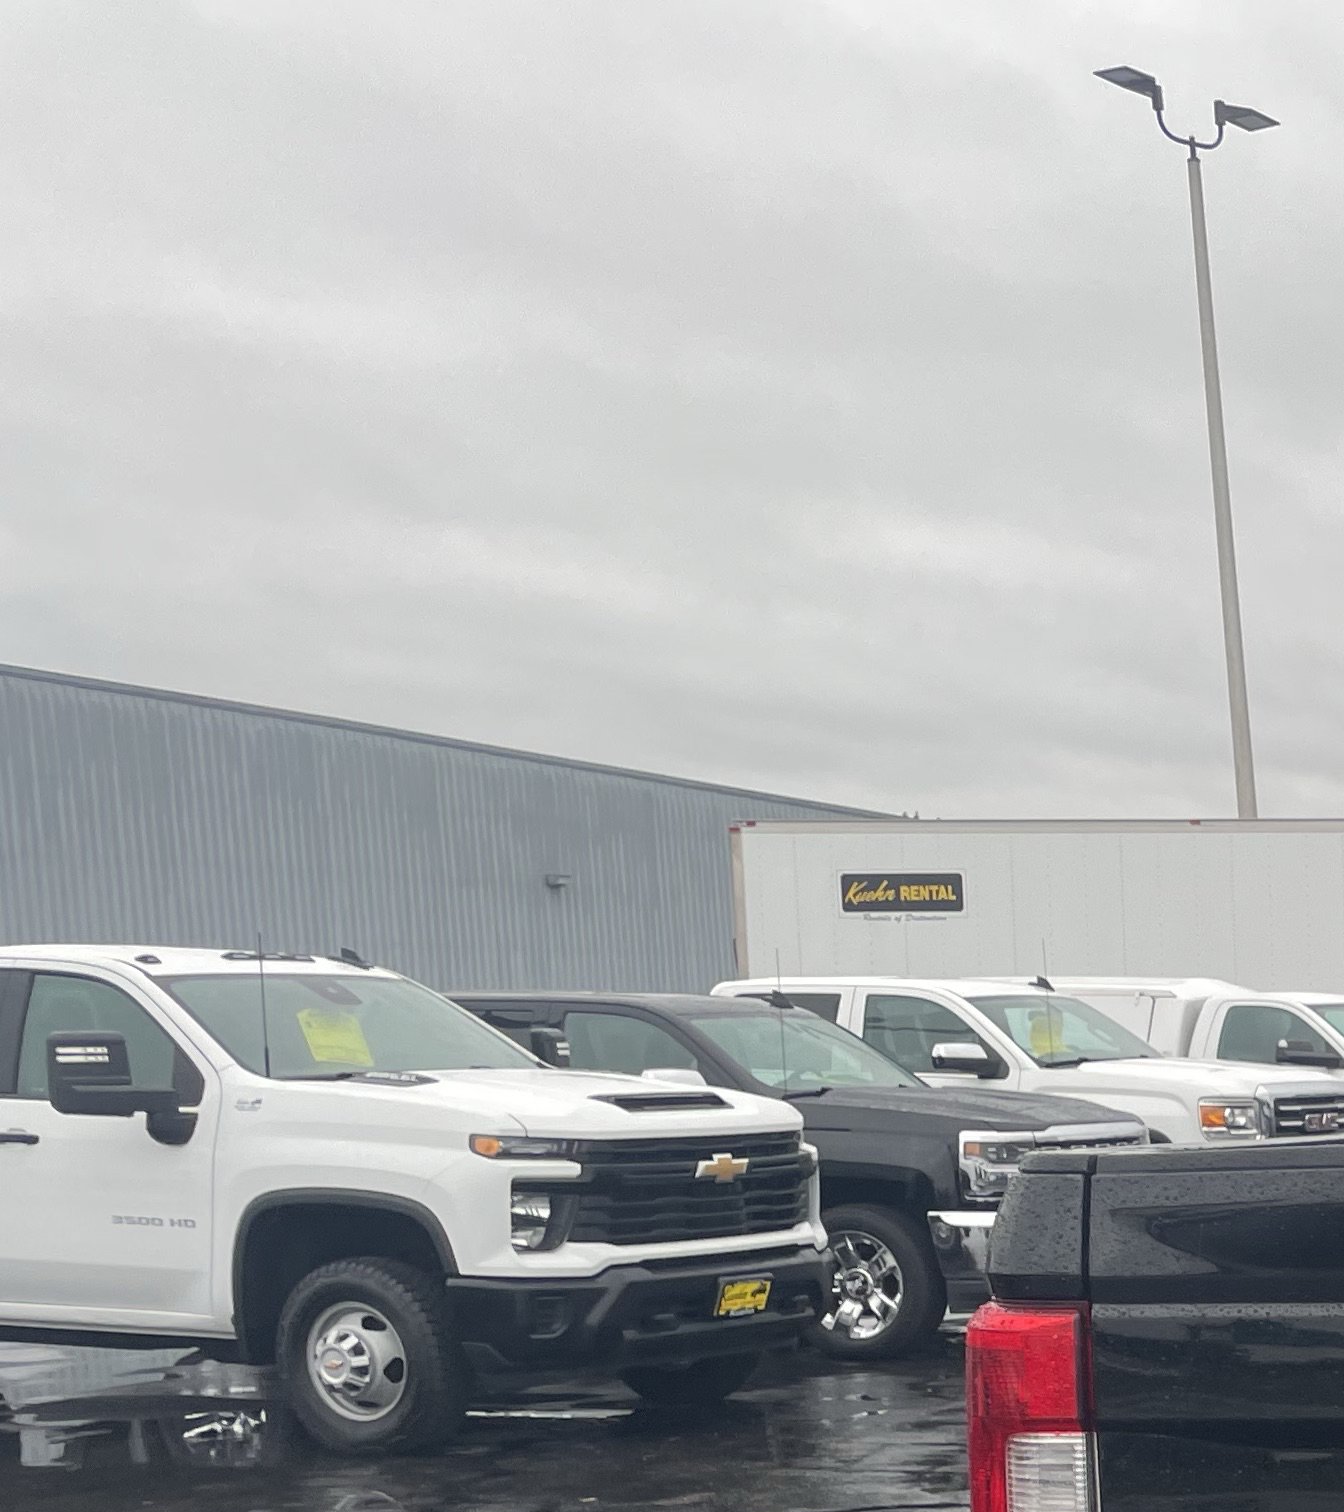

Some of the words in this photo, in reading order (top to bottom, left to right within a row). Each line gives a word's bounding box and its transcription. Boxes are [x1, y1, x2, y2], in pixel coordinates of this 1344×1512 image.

[845, 880, 896, 905] Kuehn
[900, 884, 957, 901] RENTAL
[111, 1215, 164, 1227] 3500
[169, 1218, 196, 1228] HD
